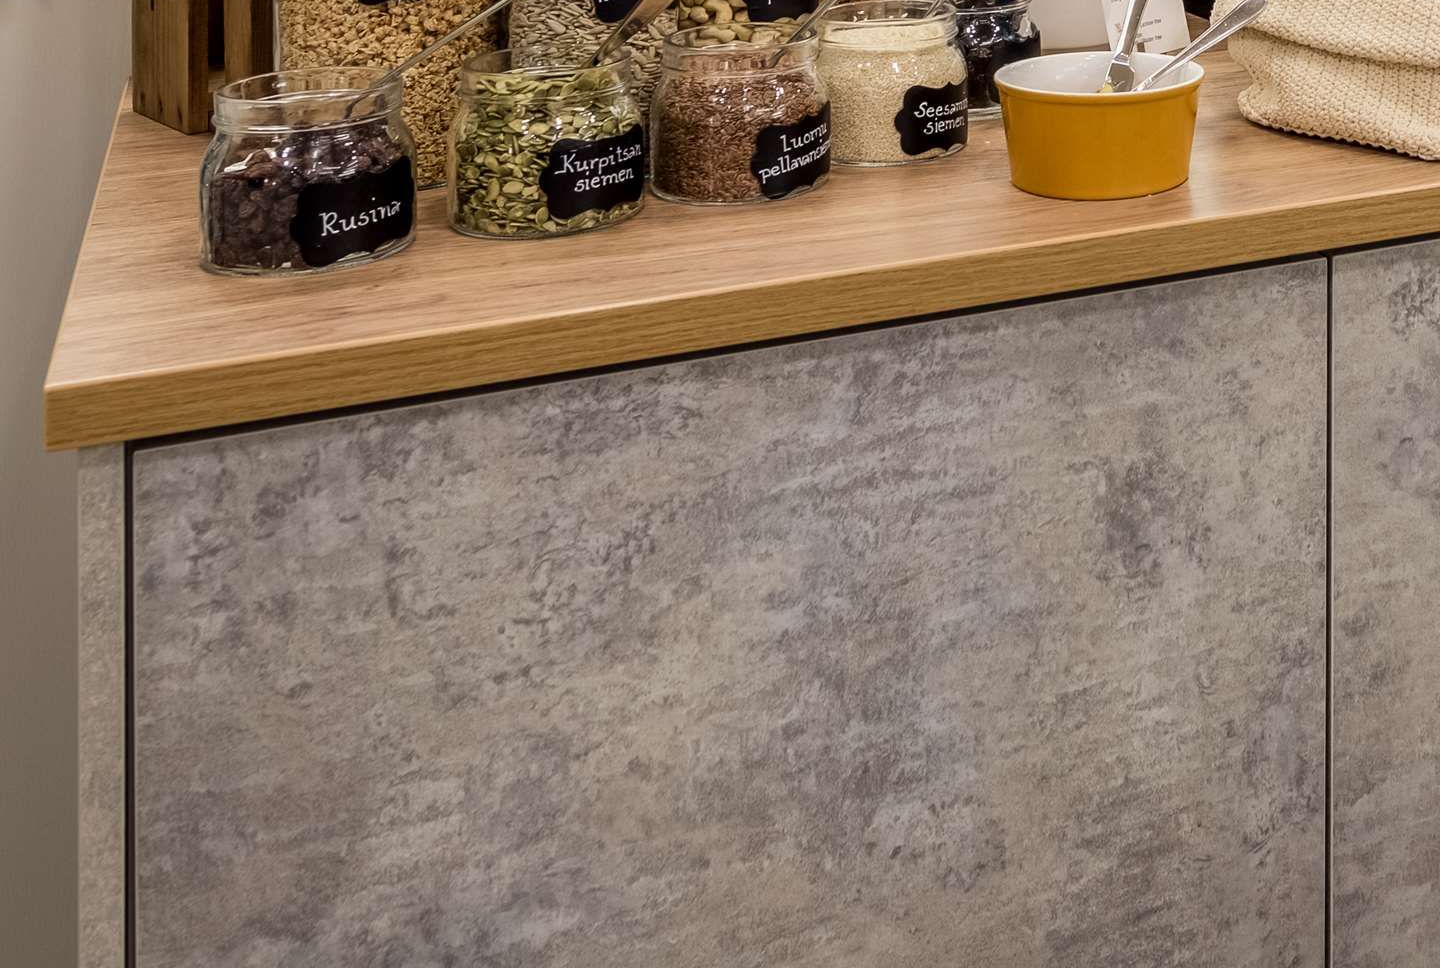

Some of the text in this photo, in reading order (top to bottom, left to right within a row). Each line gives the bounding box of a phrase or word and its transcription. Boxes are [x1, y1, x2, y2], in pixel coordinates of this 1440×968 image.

[780, 123, 827, 152] Luomu
[923, 116, 965, 135] siemen
[554, 144, 642, 175] Kurpitsan
[574, 167, 634, 192] siemen
[318, 196, 401, 236] Rusina
